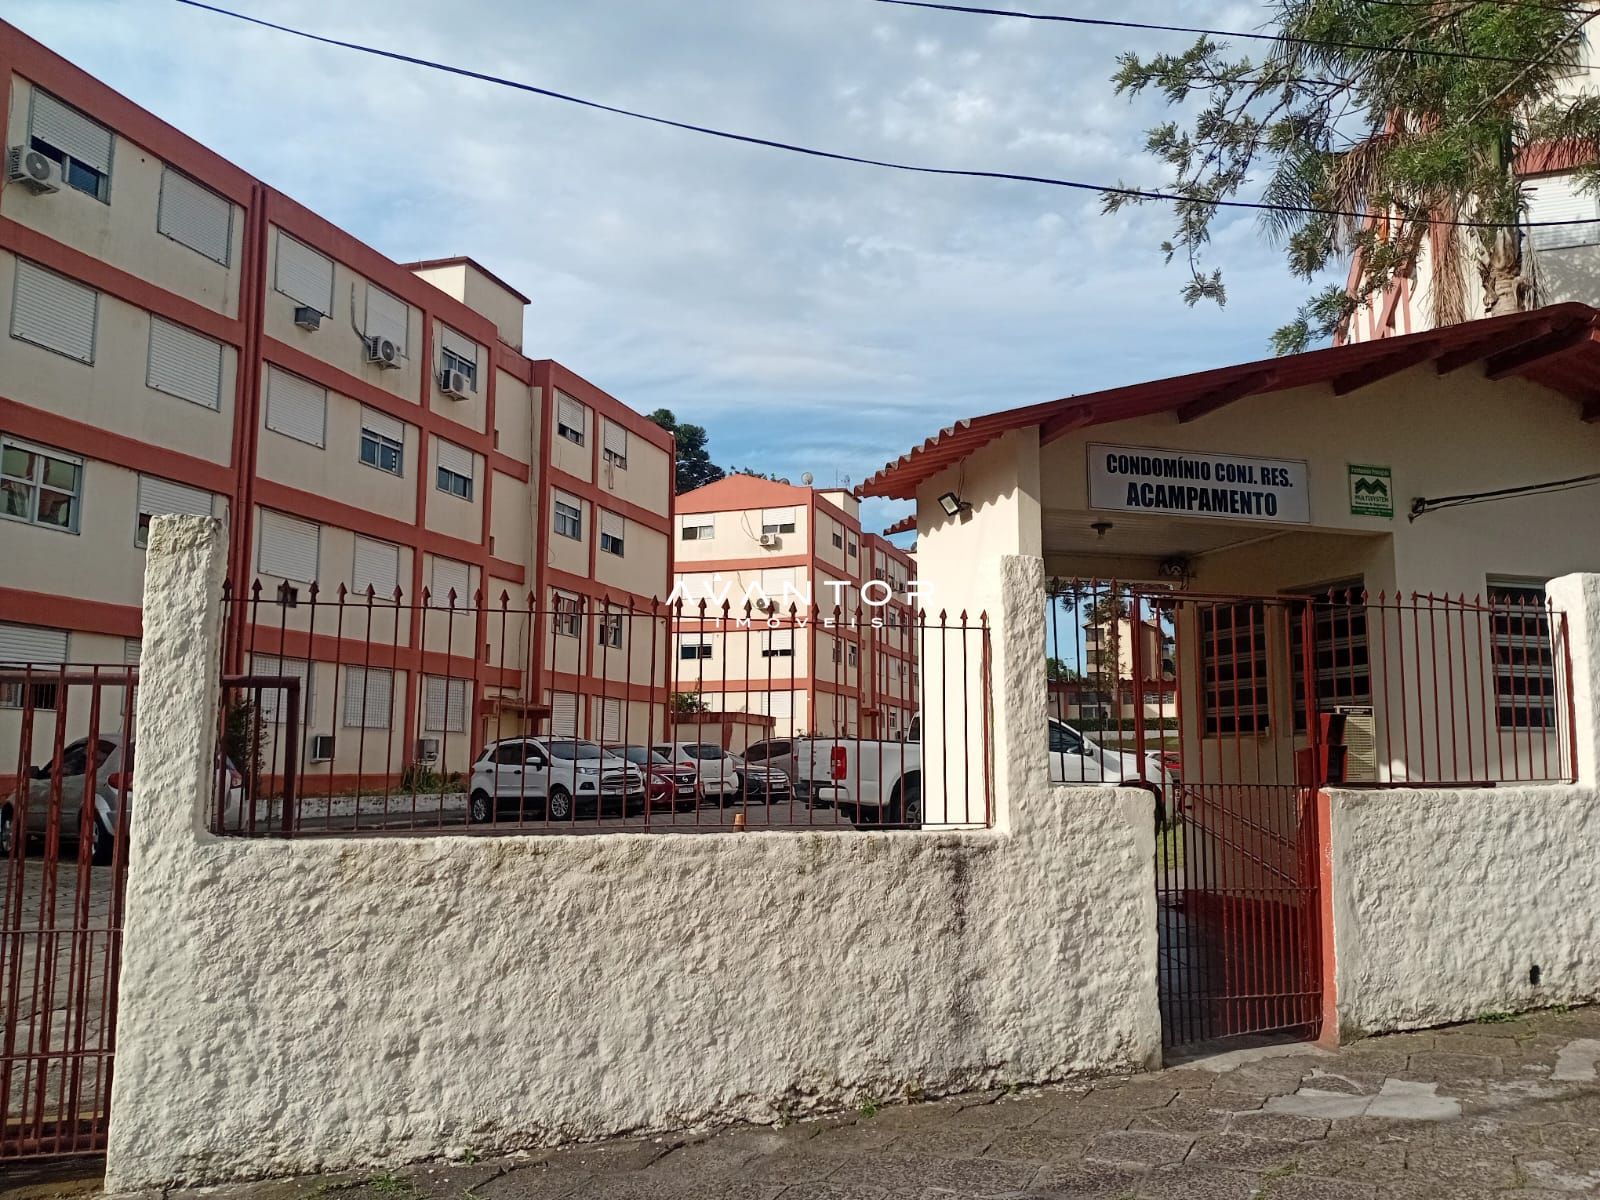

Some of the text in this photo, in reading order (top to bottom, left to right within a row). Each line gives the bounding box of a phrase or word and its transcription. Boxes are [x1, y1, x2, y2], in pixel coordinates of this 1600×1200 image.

[1106, 453, 1293, 487] CONDOMÍNIO CONJ. RES.
[1126, 482, 1278, 516] ACAMPAMENTO
